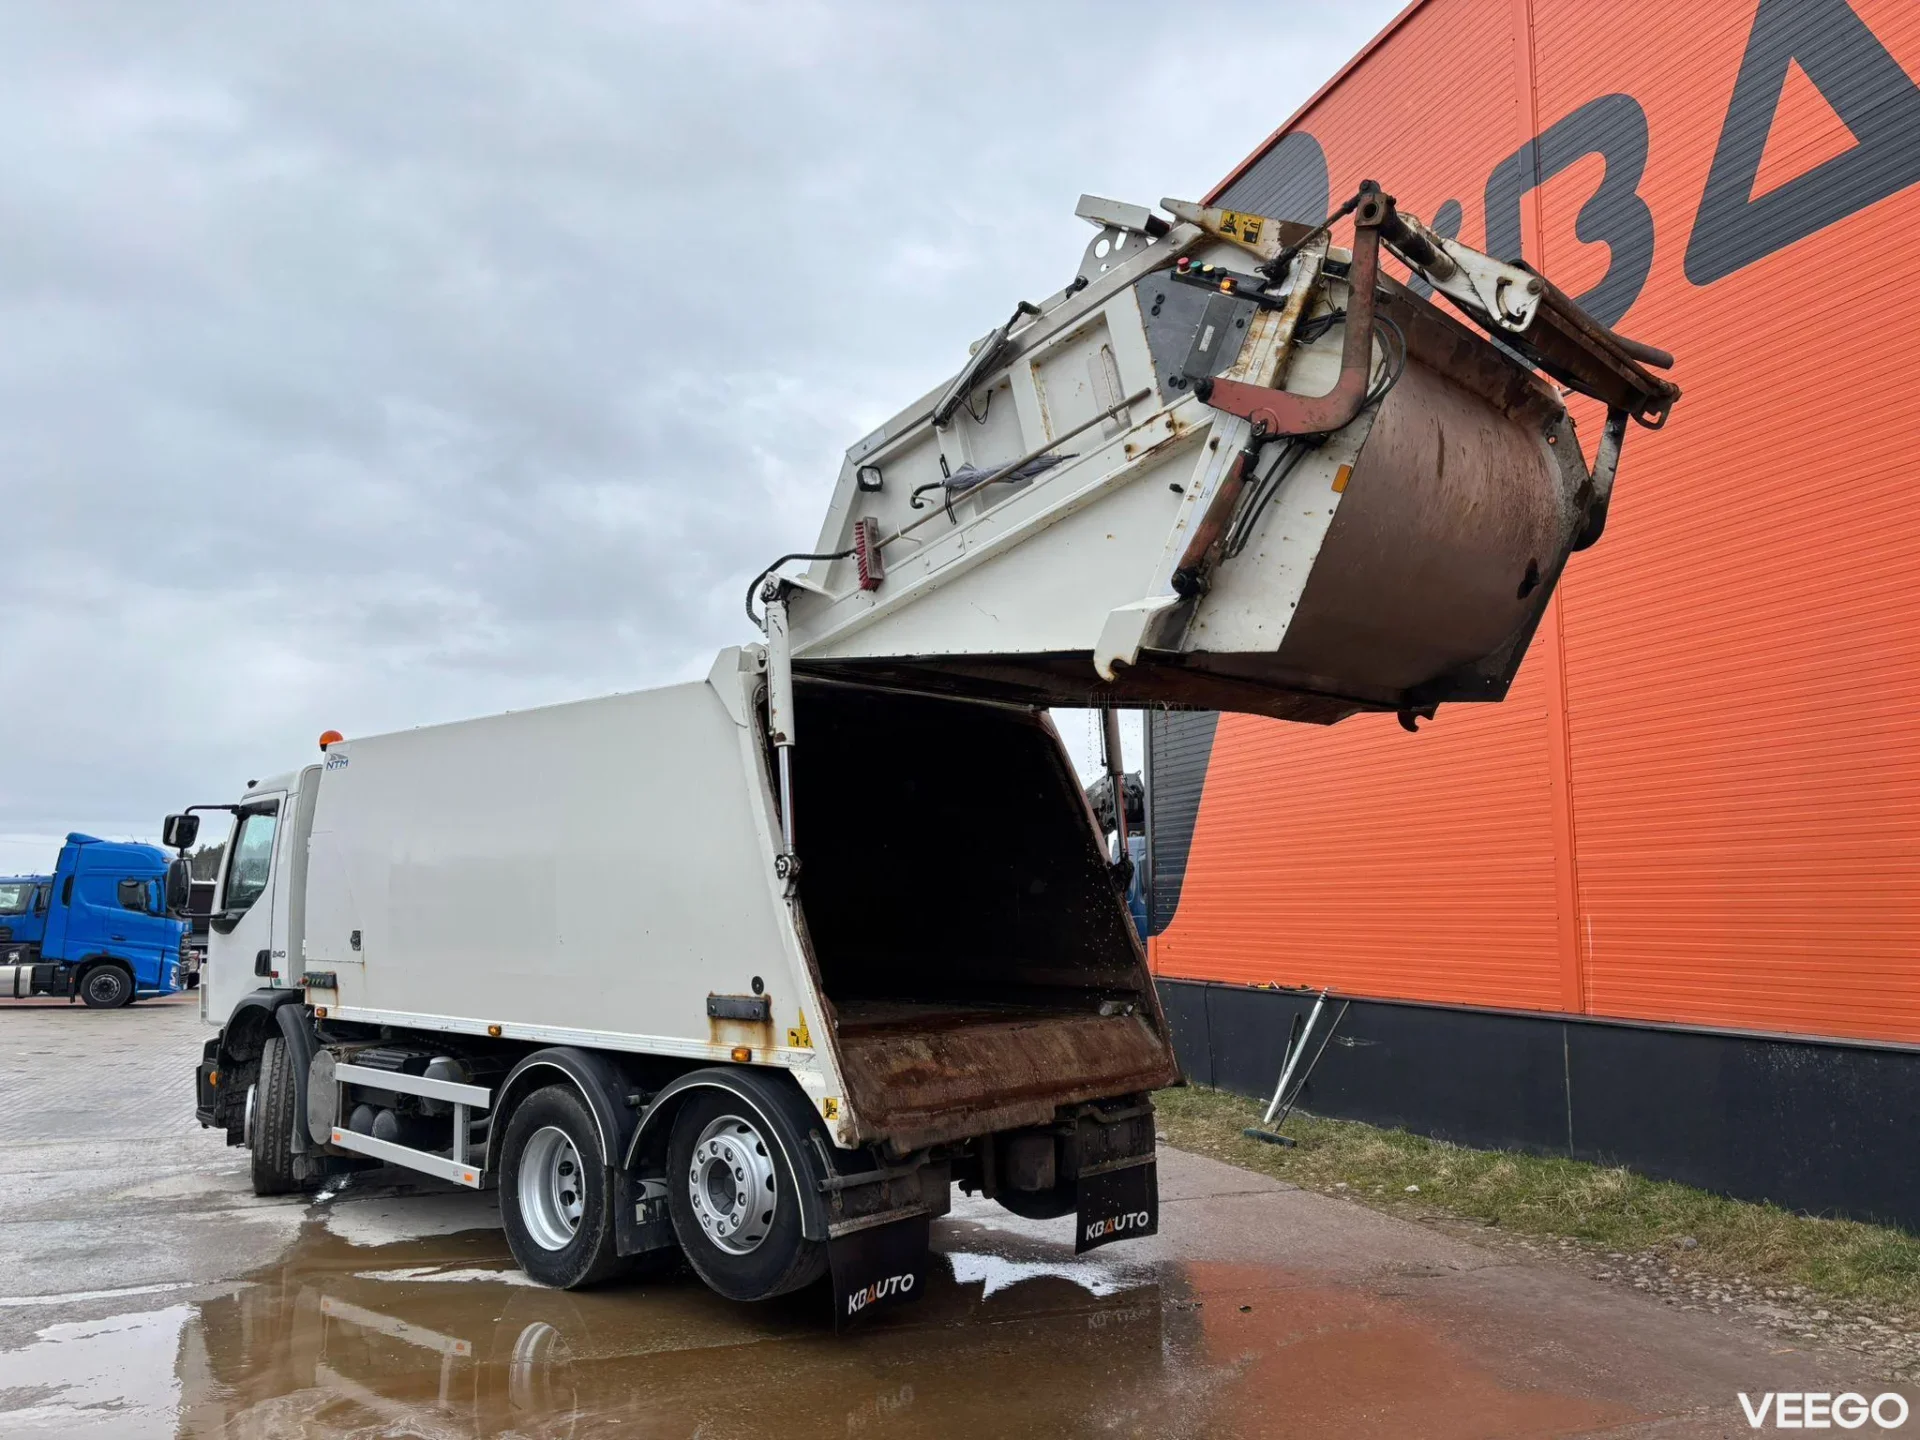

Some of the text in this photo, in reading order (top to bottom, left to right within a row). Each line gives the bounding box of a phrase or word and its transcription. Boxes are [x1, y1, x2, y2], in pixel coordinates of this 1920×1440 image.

[326, 759, 349, 770] NTM
[1086, 1211, 1149, 1241] KBAUTO
[848, 1273, 914, 1315] KBAUTO
